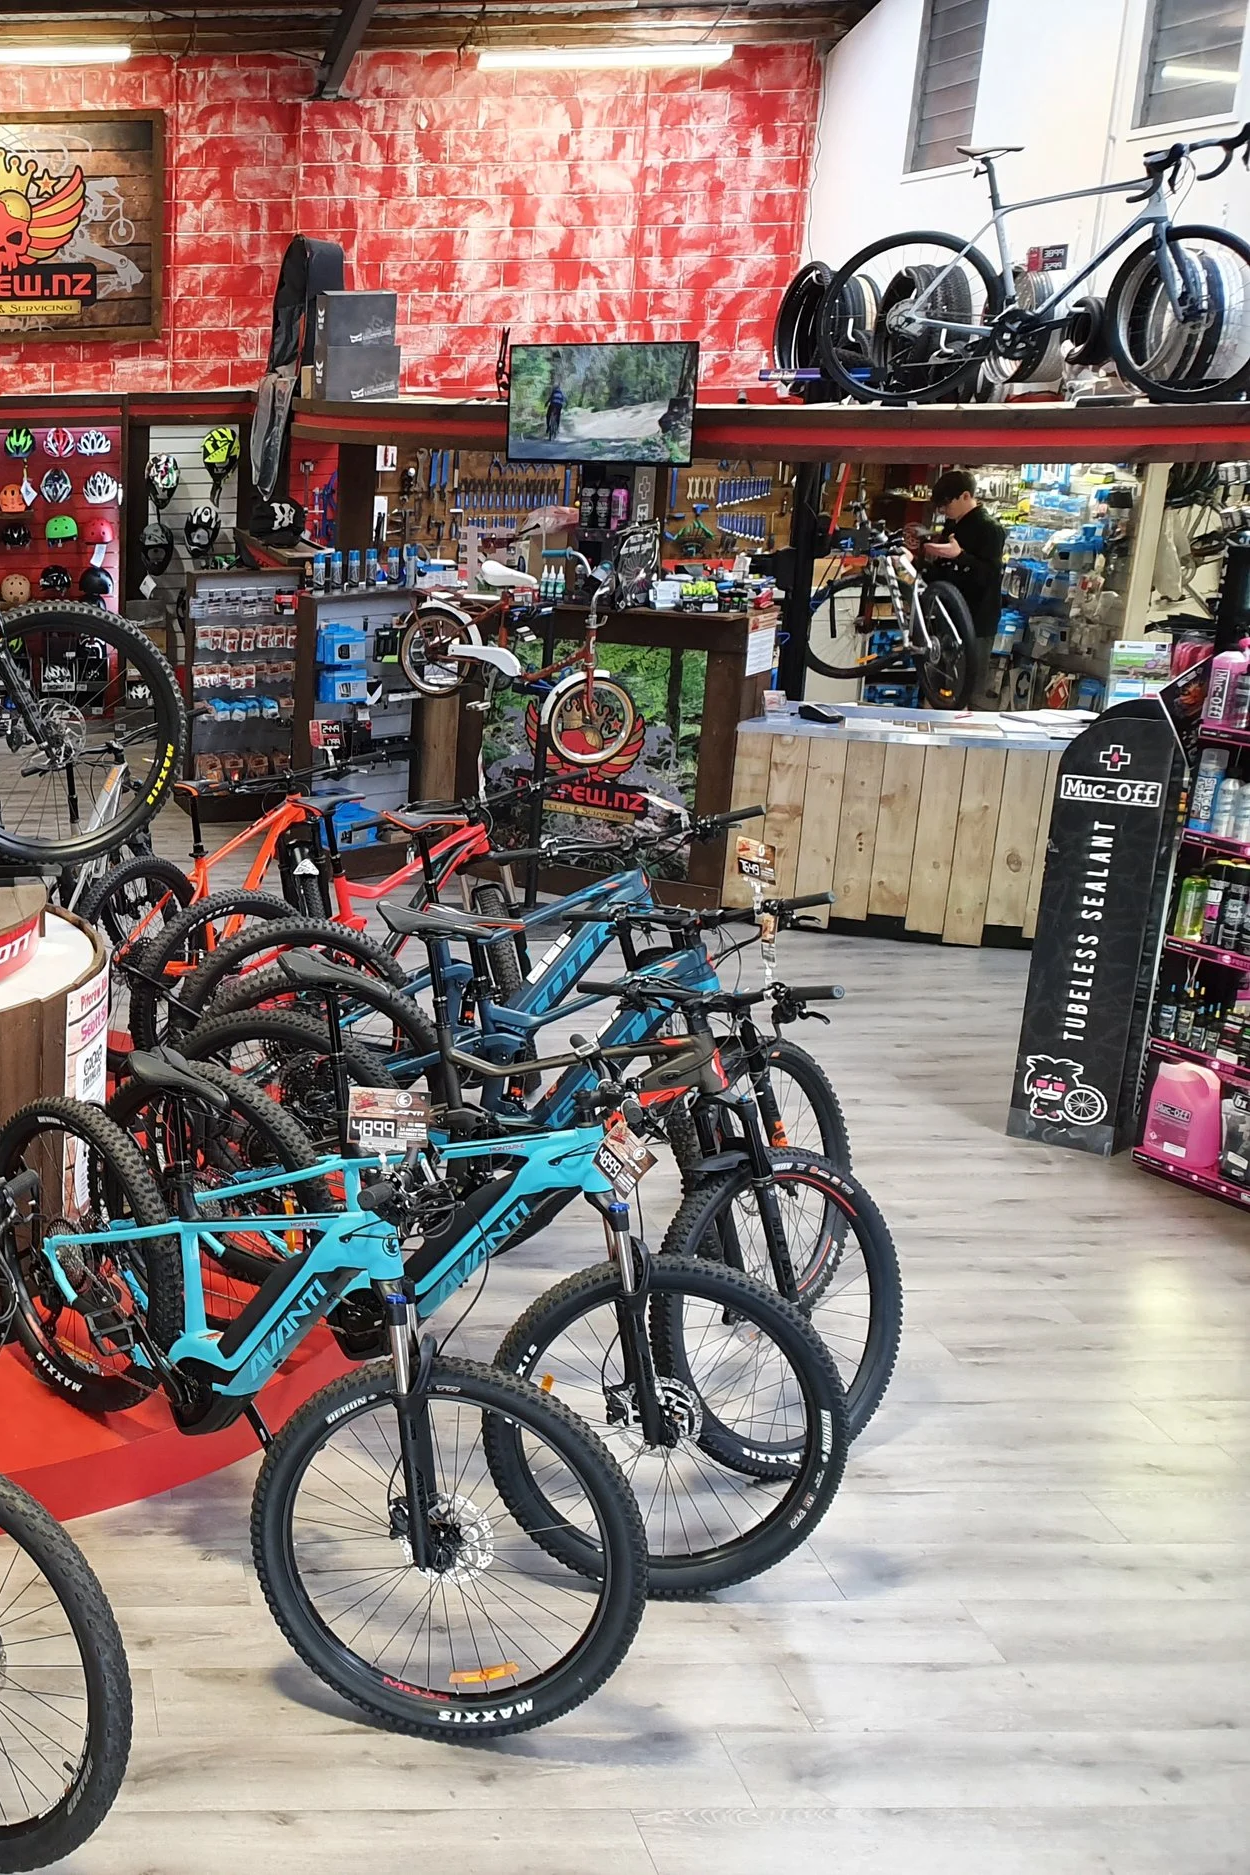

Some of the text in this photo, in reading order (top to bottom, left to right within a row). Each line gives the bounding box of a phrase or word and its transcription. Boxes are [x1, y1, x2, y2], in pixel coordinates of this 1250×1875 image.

[9, 302, 74, 314] SERVICING
[1209, 669, 1228, 718] Muc-Off
[147, 743, 174, 805] MAXXIS
[1065, 780, 1158, 804] Muc-Off
[1063, 820, 1118, 1042] TUBELESS SEALANT
[352, 1119, 395, 1138] 4899
[599, 1147, 622, 1179] 4899
[438, 1199, 533, 1298] AVANTI
[248, 1277, 327, 1380] AVANTI
[36, 1351, 84, 1393] MAXXIS
[439, 1698, 535, 1724] MAXXIS
